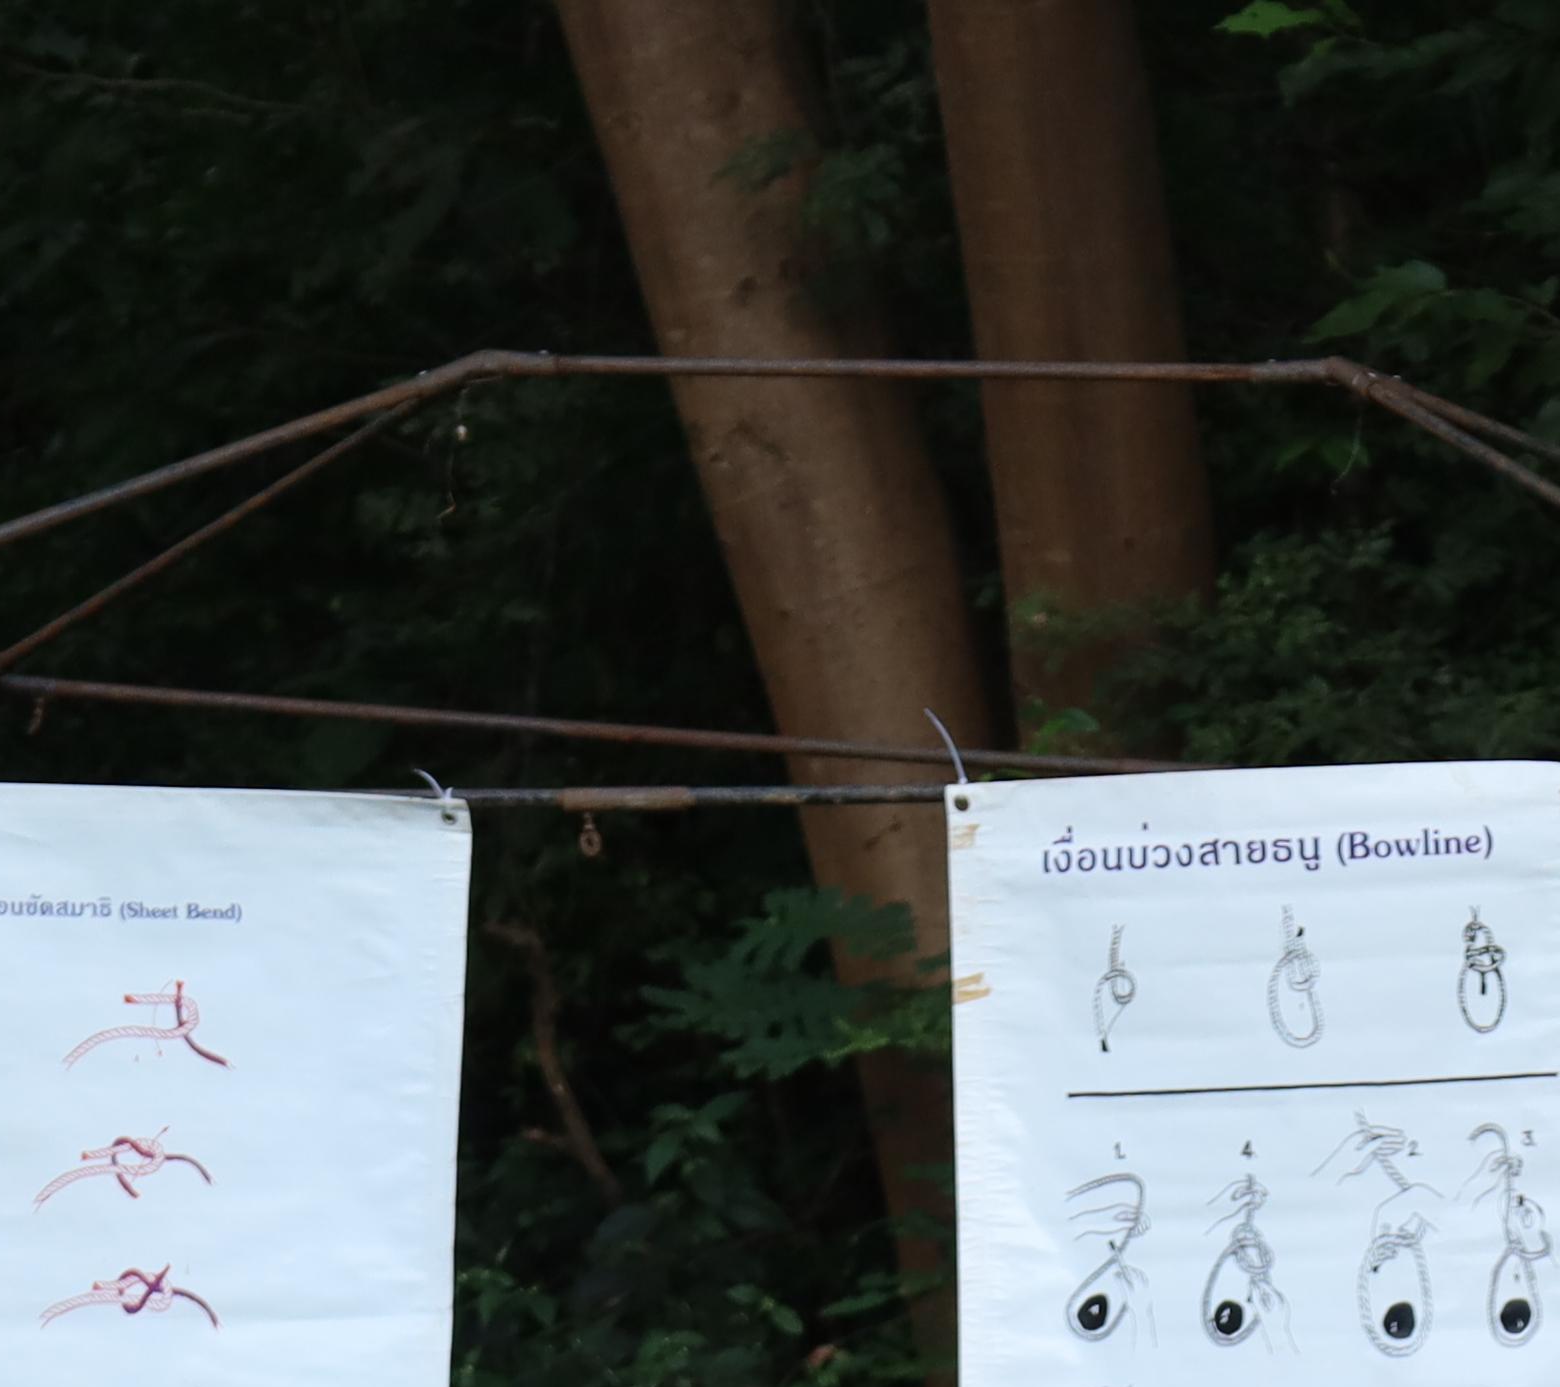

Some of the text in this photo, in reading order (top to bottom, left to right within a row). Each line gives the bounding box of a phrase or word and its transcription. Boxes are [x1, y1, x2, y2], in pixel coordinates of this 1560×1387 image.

[1043, 823, 1495, 874] เงื่อนบ่วงสายธนู (Bowline)
[120, 900, 179, 923] (Sheet
[185, 902, 243, 923] Bend)
